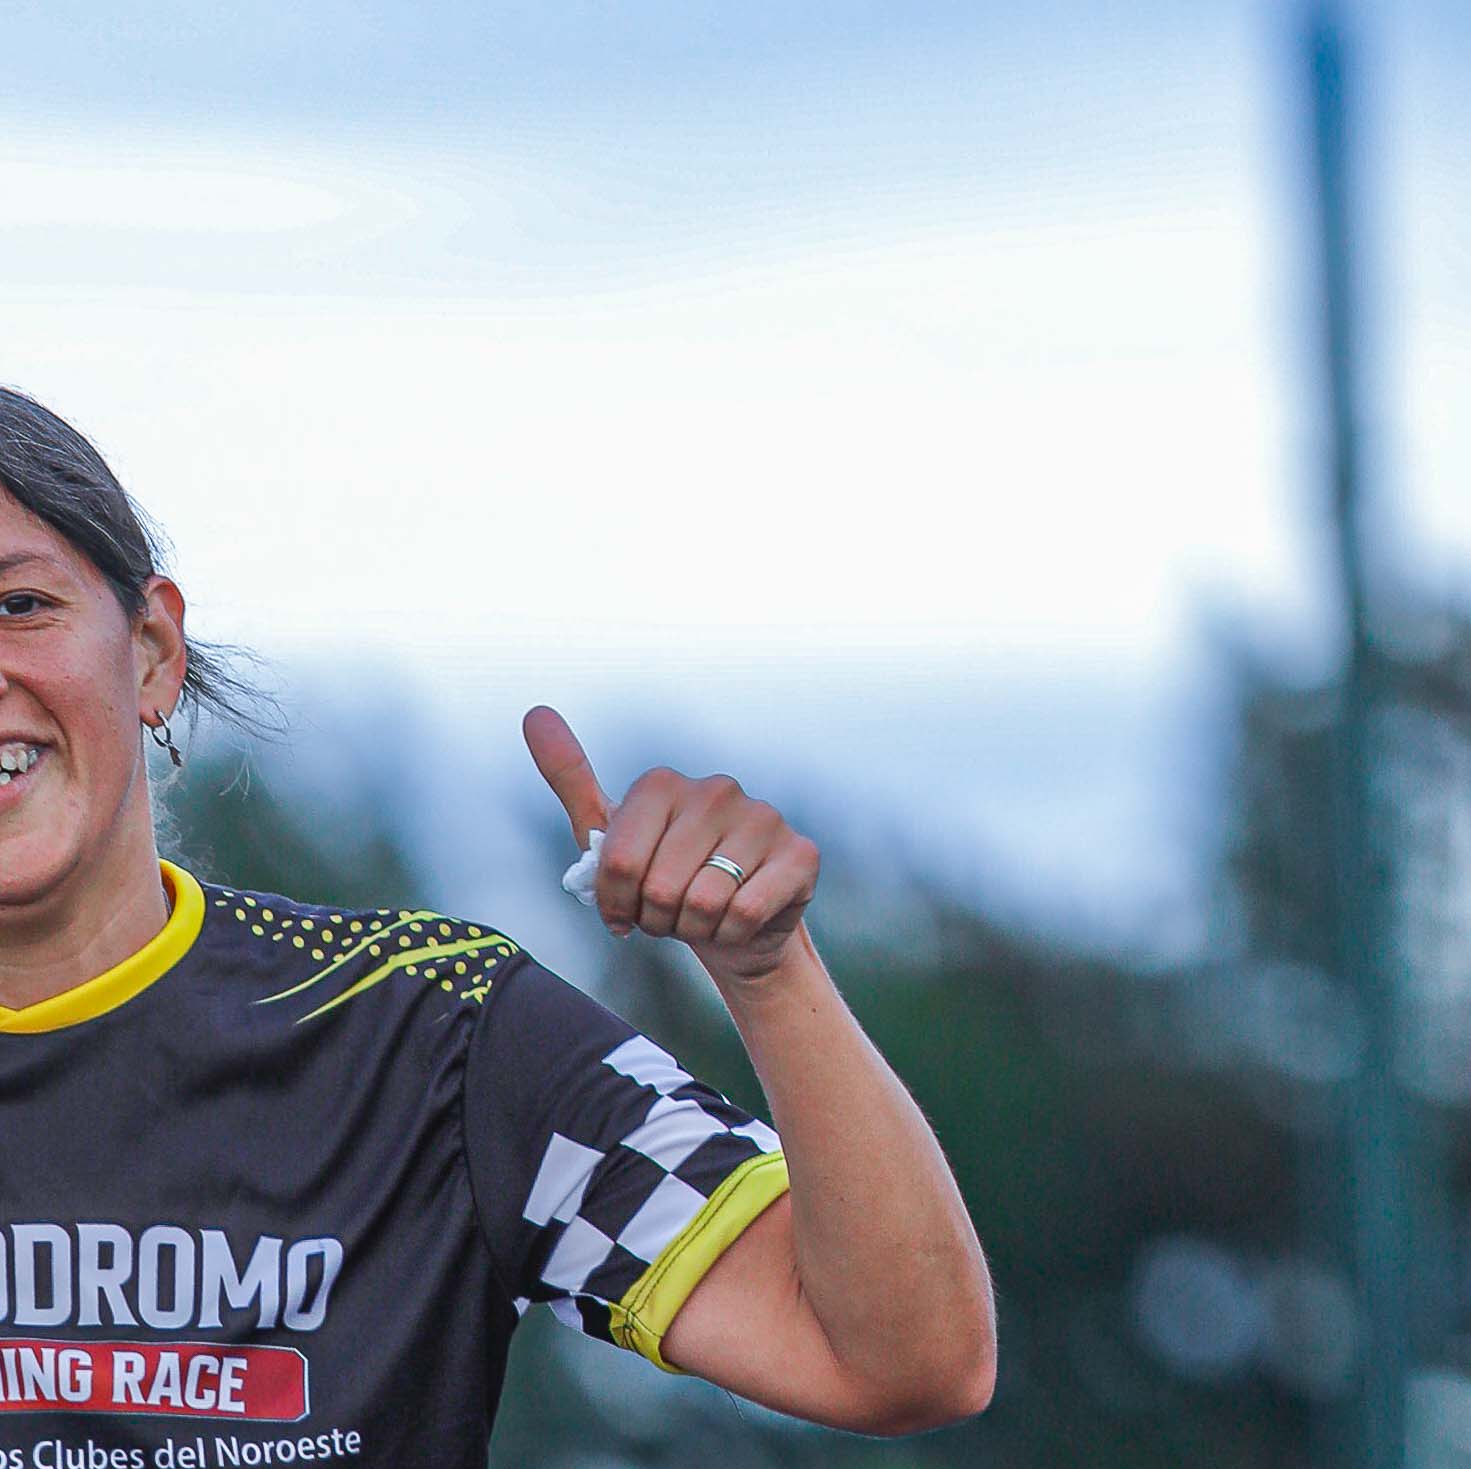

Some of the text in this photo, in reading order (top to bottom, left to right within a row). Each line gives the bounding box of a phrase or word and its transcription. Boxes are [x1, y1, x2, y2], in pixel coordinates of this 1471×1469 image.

[112, 1350, 248, 1413] RACE
[154, 1437, 206, 1469] del
[214, 1427, 361, 1467] Noroeste
